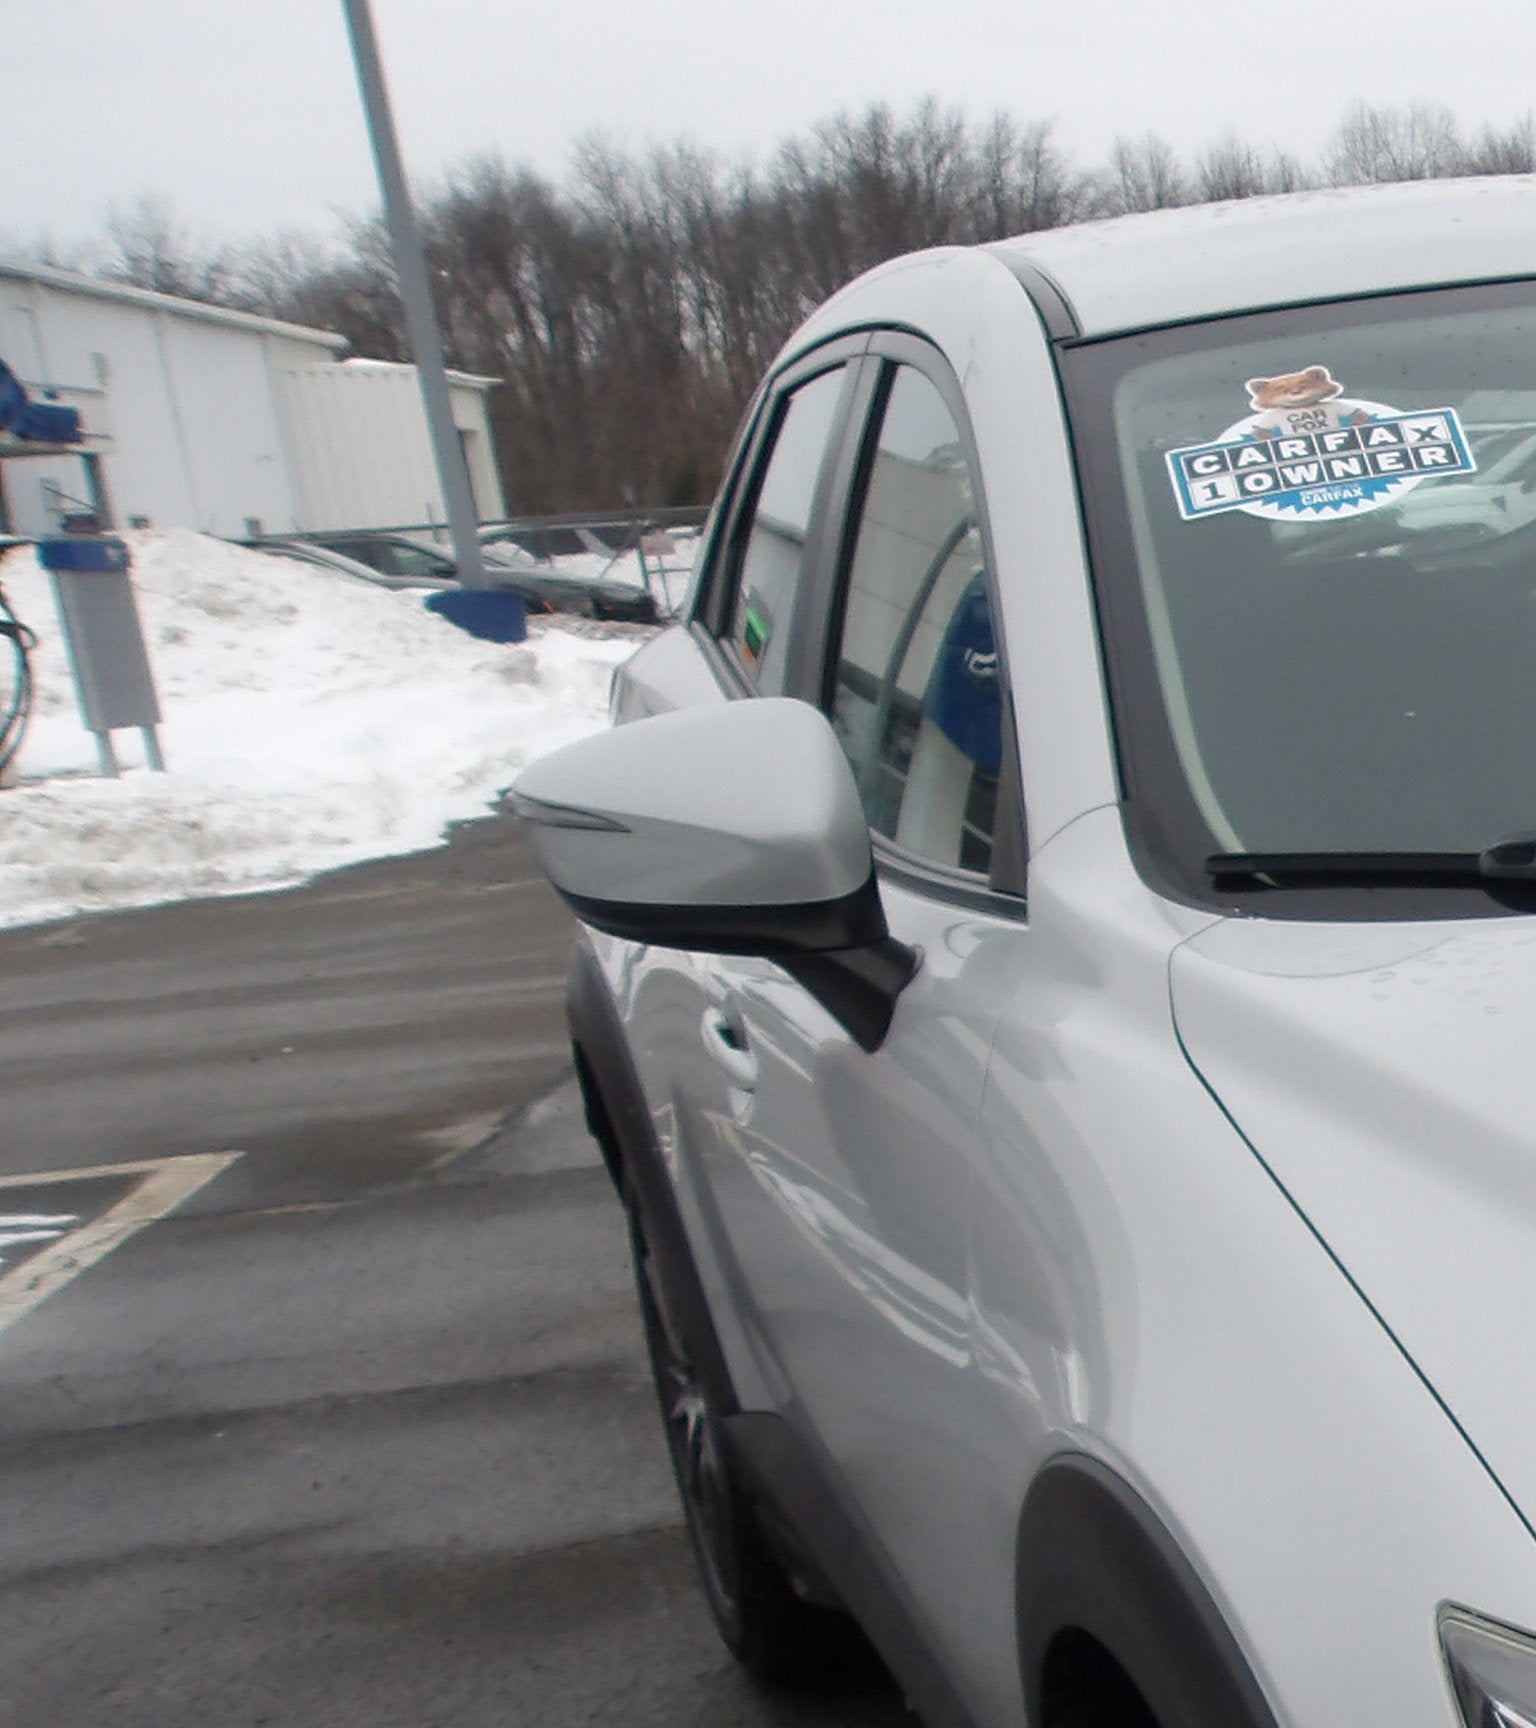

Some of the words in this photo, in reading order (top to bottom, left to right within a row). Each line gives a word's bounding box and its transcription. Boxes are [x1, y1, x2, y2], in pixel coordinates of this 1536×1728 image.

[1286, 408, 1328, 424] CAR
[1291, 418, 1329, 433] FOX
[1192, 423, 1444, 475] CARFAX
[1202, 480, 1226, 502] 1
[1242, 444, 1450, 494] OWNER
